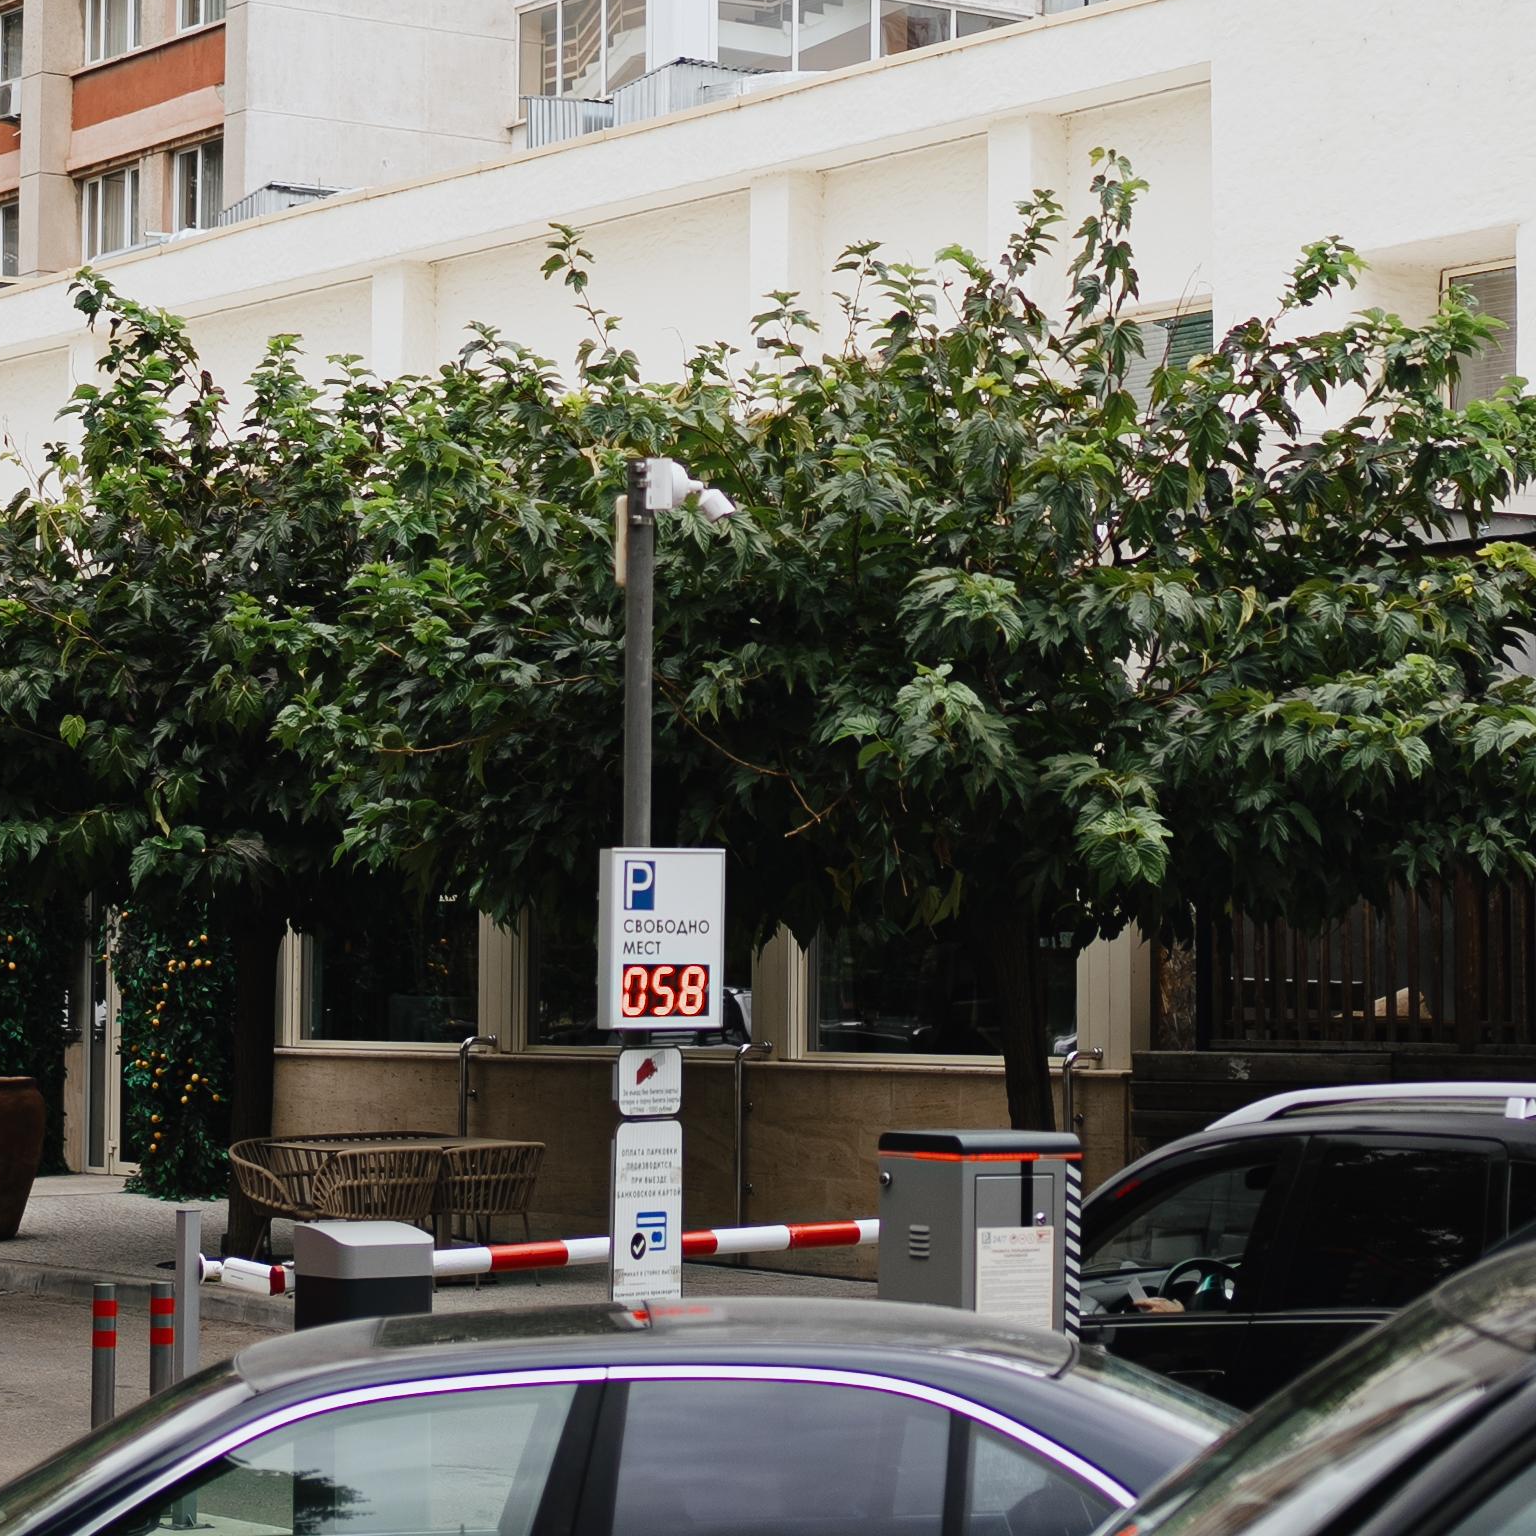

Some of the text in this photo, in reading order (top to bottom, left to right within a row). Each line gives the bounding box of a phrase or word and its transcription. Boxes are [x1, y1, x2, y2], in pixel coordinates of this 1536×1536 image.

[626, 862, 653, 909] P
[623, 919, 710, 935] СВОБОДНО
[623, 940, 662, 955] МЕСТ
[622, 965, 707, 1017] 058
[621, 1147, 678, 1157] ОПЛАТА ПАРКОВКИ
[631, 1175, 667, 1184] ПРИ ВЫЕЗДЕ
